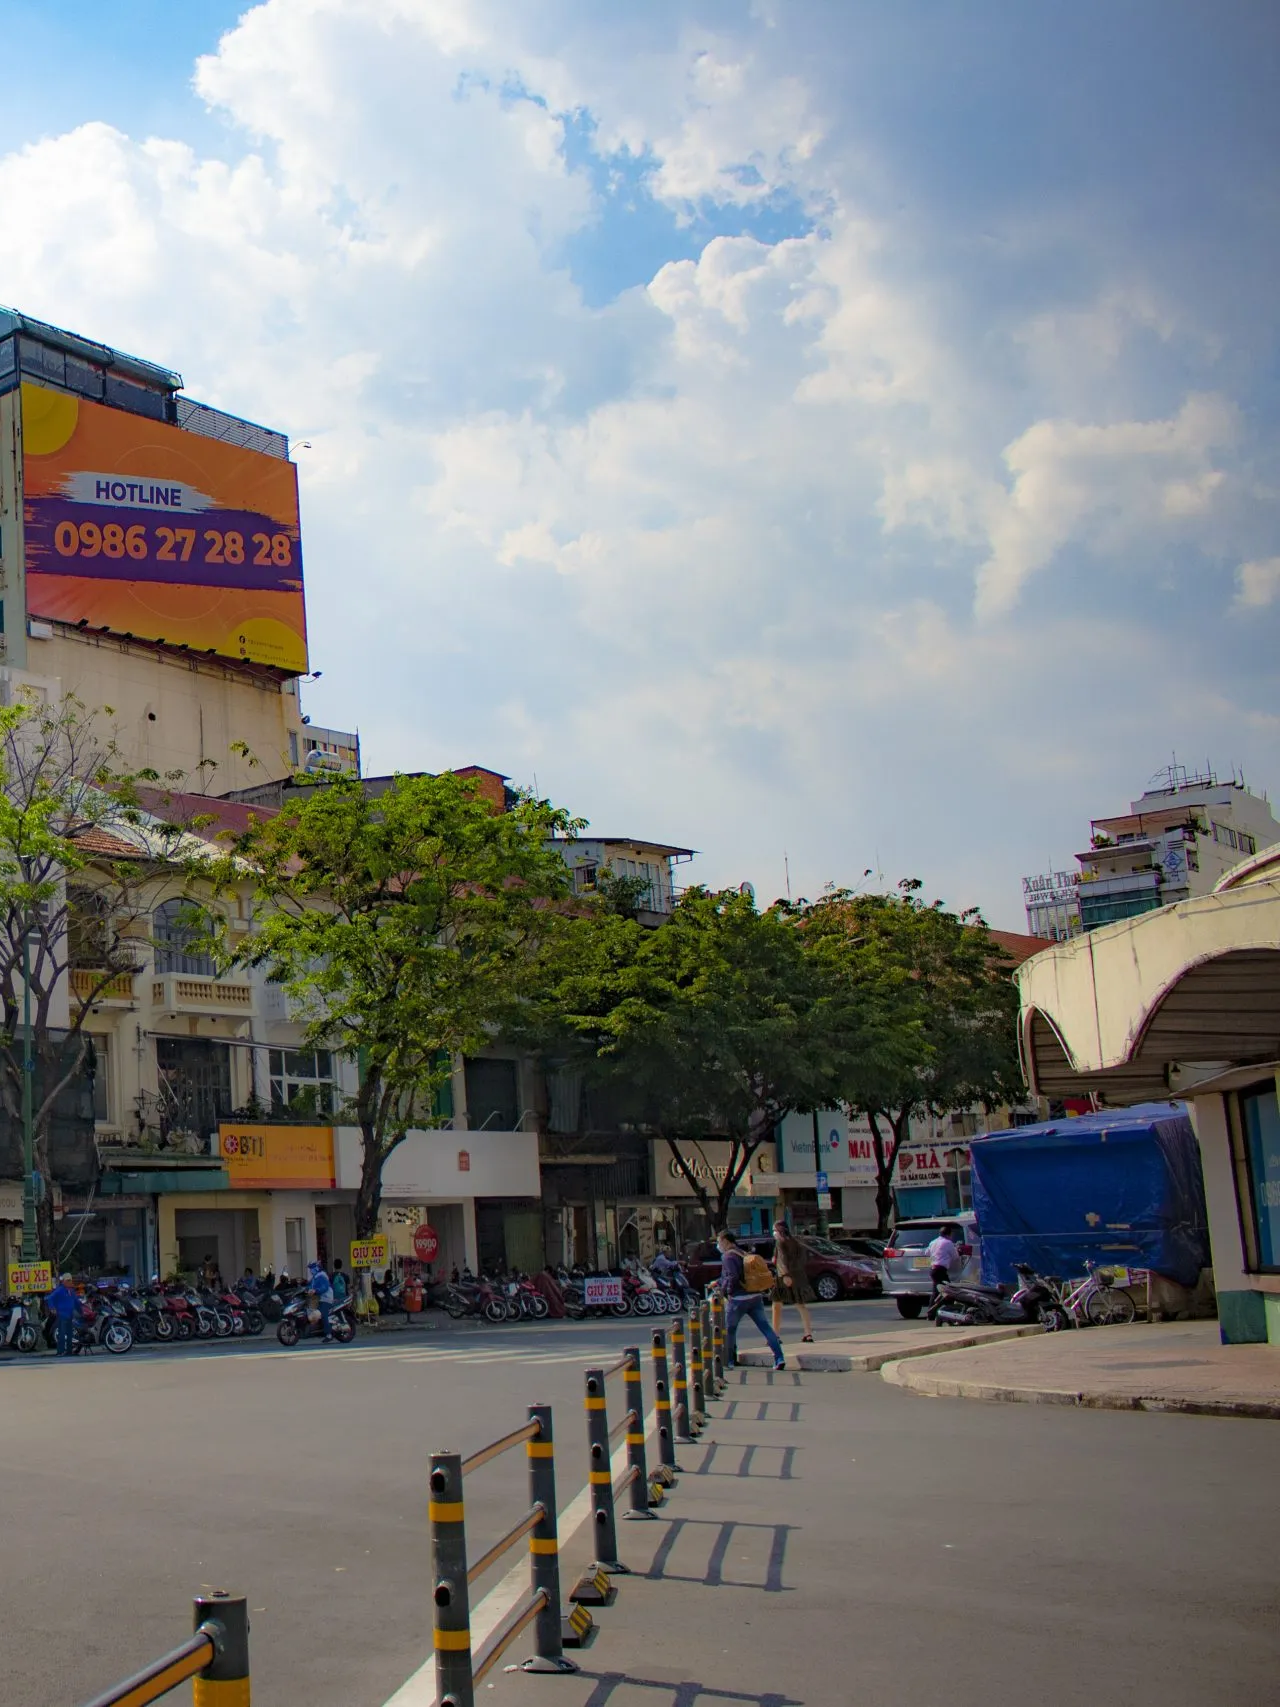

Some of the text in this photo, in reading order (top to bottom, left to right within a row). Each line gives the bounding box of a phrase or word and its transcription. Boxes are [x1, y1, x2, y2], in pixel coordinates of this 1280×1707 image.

[95, 479, 182, 507] HOTLINE
[54, 520, 292, 568] 0986 27 28 28
[848, 1139, 871, 1159] MAI
[915, 1148, 941, 1169] HÀ
[371, 1245, 384, 1257] XE
[34, 1268, 49, 1283] XE
[606, 1284, 619, 1296] XE
